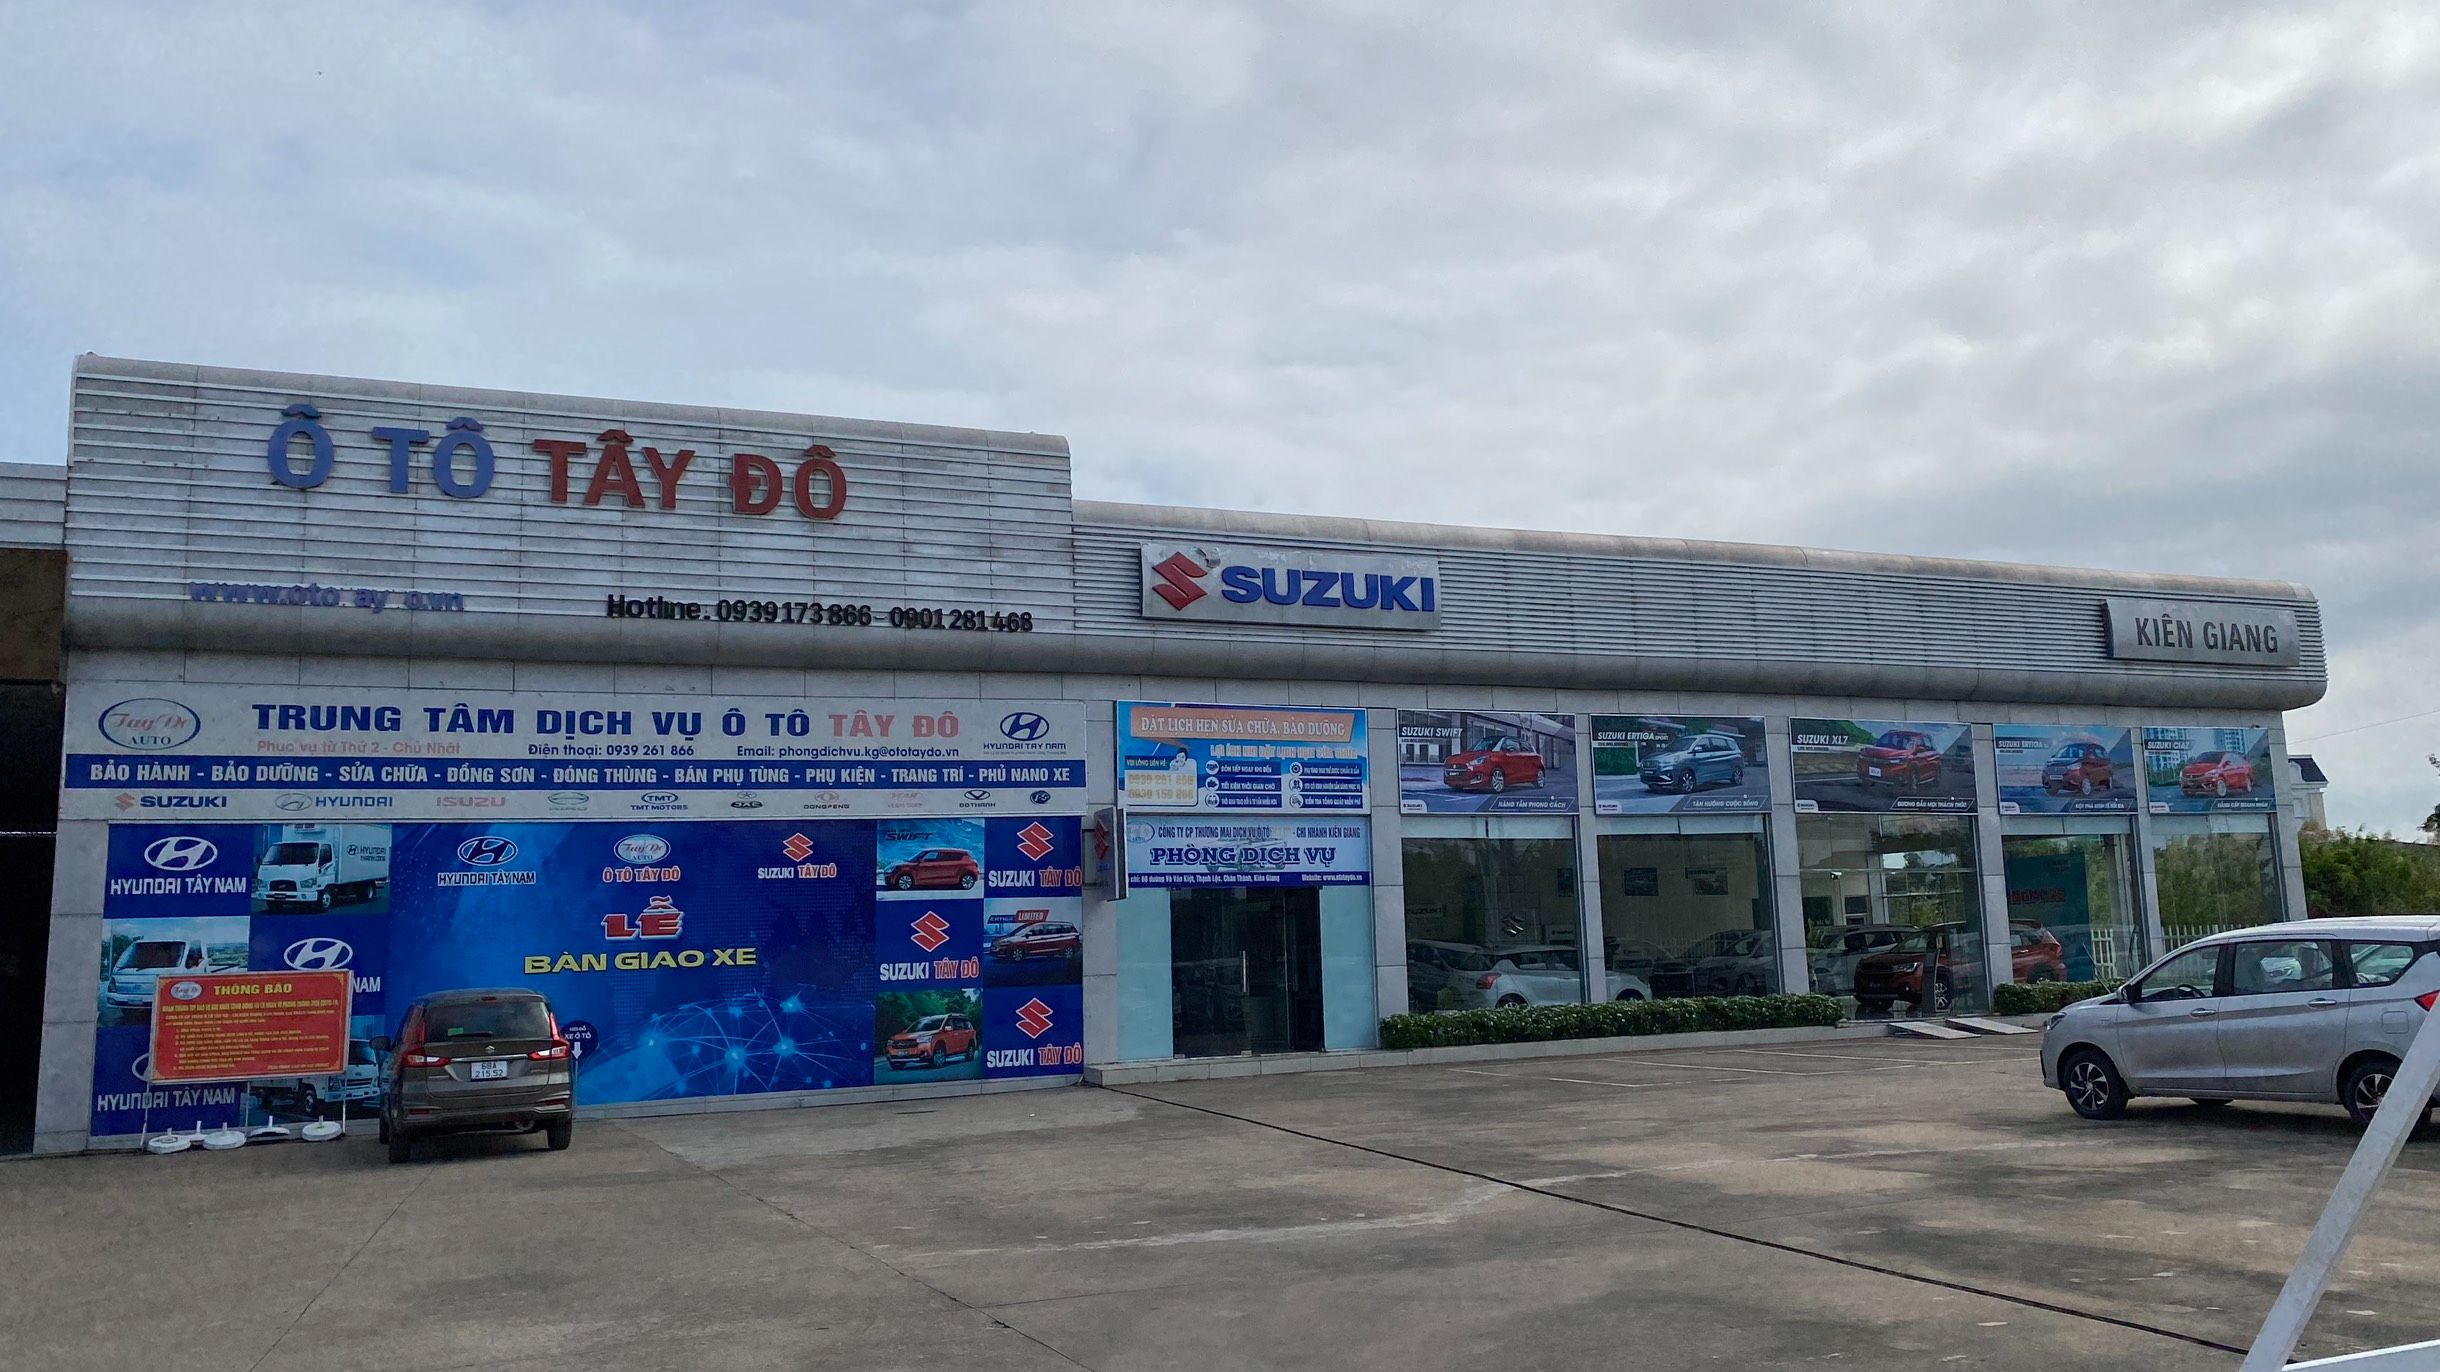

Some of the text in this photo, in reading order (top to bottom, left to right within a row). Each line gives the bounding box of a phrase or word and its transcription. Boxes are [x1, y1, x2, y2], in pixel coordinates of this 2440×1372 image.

[266, 404, 848, 520] Ô TÔ TÂY ĐÔ
[1220, 565, 1435, 612] SUZUKI
[2135, 613, 2278, 653] KIÊN GIANG
[252, 702, 960, 741] TRUNG TÂM DỊCH VỤ Ô TÔ TÂY ĐÔ
[1196, 720, 1219, 737] HẸN
[128, 735, 172, 745] AUTO
[1401, 726, 1463, 737] SUZUKI SWIFT
[1597, 731, 1625, 740] SUZUKI
[1627, 732, 1655, 740] ERTIGA
[1797, 735, 1848, 745] SUZUKI XL7
[528, 743, 694, 760] Điện thoại: 0939 261 866
[737, 745, 960, 760] Email: phongdichvu.kg@ototaydo.vn
[2147, 741, 2171, 749] SUZUKI
[90, 760, 129, 781] BẢO
[137, 761, 190, 782] HÀNH
[211, 760, 249, 782] BẢO
[255, 762, 319, 782] DƯỠNG
[339, 761, 375, 782] SỬA
[380, 764, 428, 783] CHỮA
[500, 766, 535, 784] SƠN
[553, 763, 599, 784] ĐÓNG
[604, 764, 657, 784] THÙNG
[674, 764, 707, 784] BÁN
[712, 767, 743, 787] PHỤ
[749, 765, 789, 784] TÙNG
[806, 768, 836, 786] PHỤ
[840, 765, 875, 787] KIỆN
[891, 768, 937, 783] TRANG
[942, 765, 964, 783] TRÍ
[979, 763, 1007, 783] PHỦ
[1011, 767, 1049, 782] NANO
[1053, 767, 1070, 782] XE
[140, 796, 227, 808] SUZUKI
[315, 796, 393, 807] HYUNDAI
[436, 796, 506, 807] ISUZU
[648, 794, 674, 802] TMT
[651, 803, 688, 811] MOTORS
[886, 831, 933, 841] SWIFT
[1185, 826, 1193, 838] CP
[1151, 844, 1336, 867] PHÒNG DỊCH VỤ
[438, 868, 536, 886] HYUNDAI TÂY NAM
[603, 865, 680, 883] Ô TÔ TÂY ĐÔ
[758, 862, 837, 879] SUZUKI TÂY ĐÔ
[988, 869, 1034, 887] SUZUKI
[1039, 866, 1062, 887] TÂY
[1064, 865, 1082, 887] ĐÔ
[110, 873, 247, 895] HYUNDAI TÂY NAM
[601, 895, 685, 940] LỄ
[1018, 911, 1044, 921] LIMITED
[524, 948, 757, 974] BÀN GIAO XE
[879, 956, 979, 980] SUZUKI TÂY ĐÔ
[214, 982, 260, 996] THÔNG
[986, 1042, 1082, 1068] SUZUKI TÂY ĐÔ
[97, 1085, 235, 1111] HYUNDAI TÂY NAM
